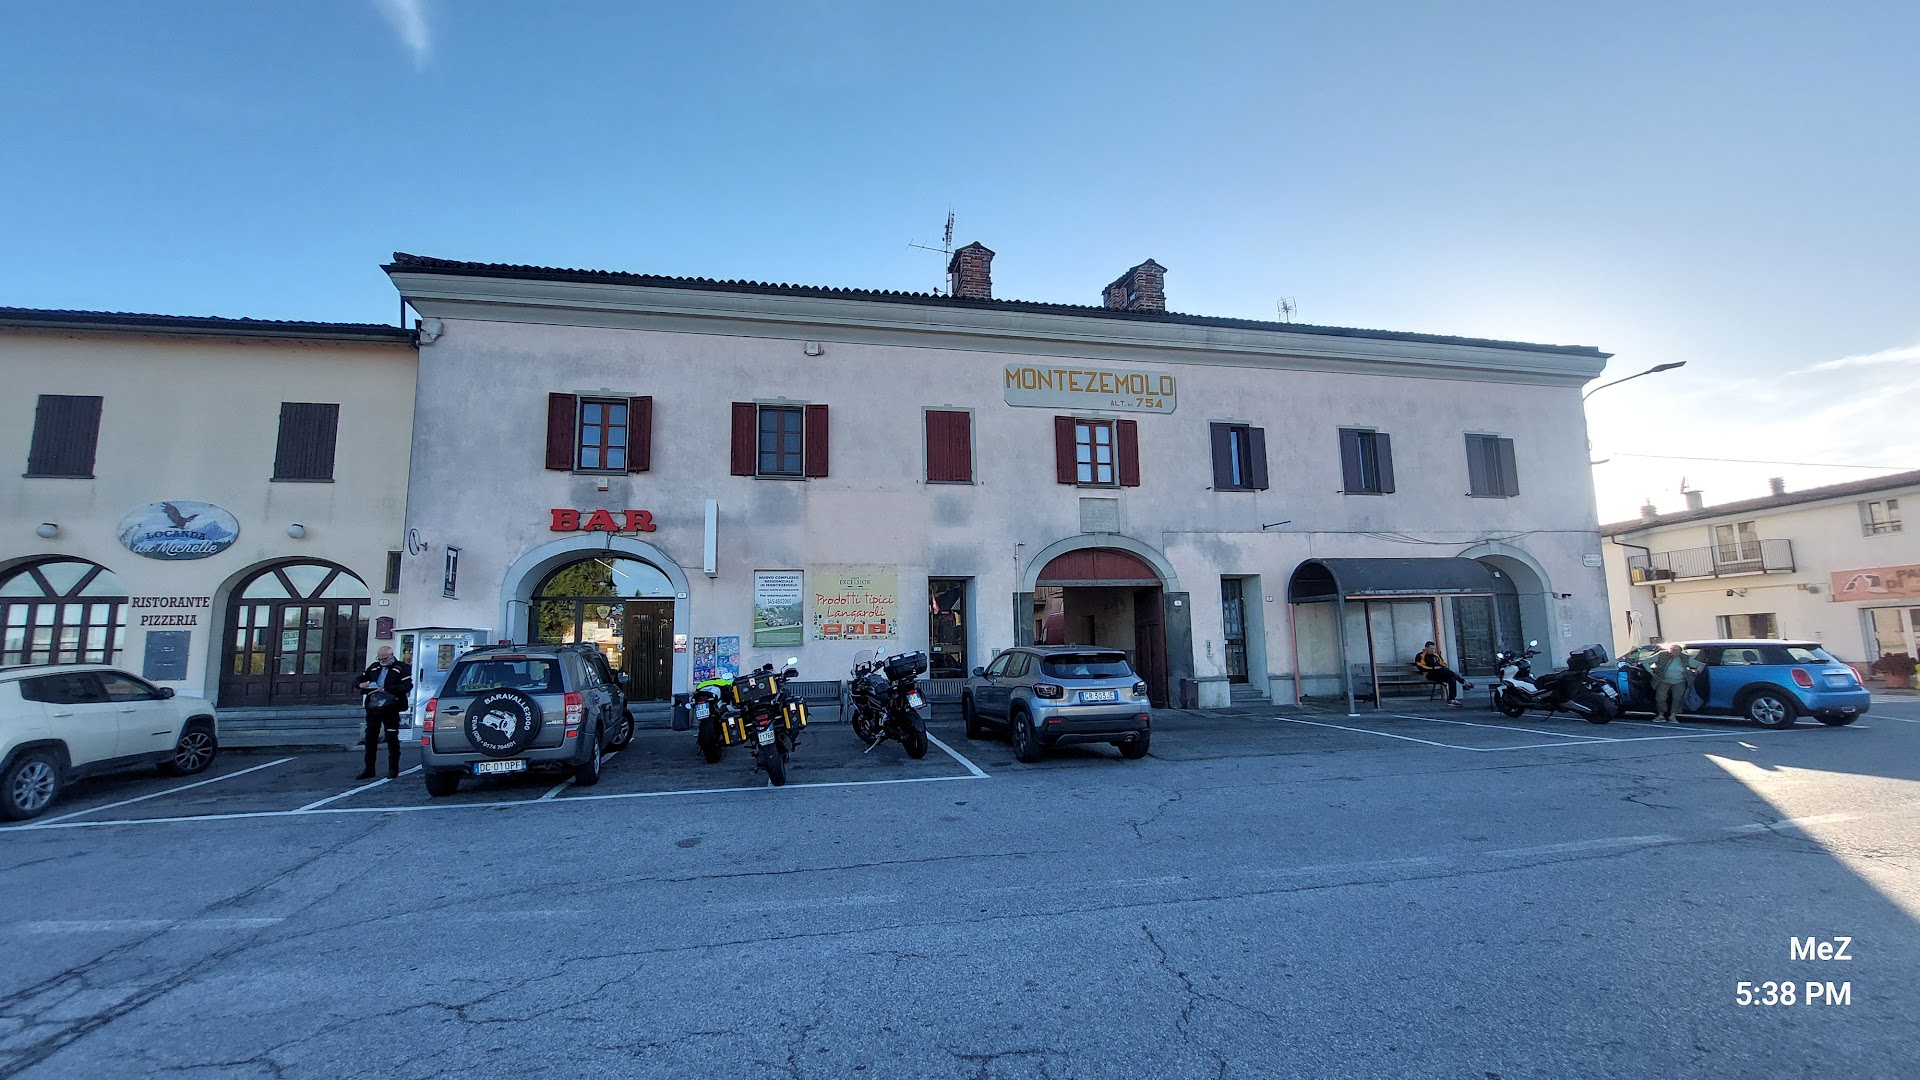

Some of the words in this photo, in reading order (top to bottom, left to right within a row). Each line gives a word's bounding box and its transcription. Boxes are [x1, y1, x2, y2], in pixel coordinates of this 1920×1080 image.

[1005, 368, 1173, 396] MONTEZEMOLO
[1136, 398, 1163, 408] 754
[550, 508, 657, 532] BAR
[145, 530, 207, 540] LOCANDA
[157, 540, 219, 556] Michelle
[131, 596, 211, 608] RISTORANTE
[815, 592, 862, 605] Prodotti
[865, 592, 895, 609] tipici
[140, 614, 198, 626] PIZZERIA
[826, 606, 886, 622] Langaroli
